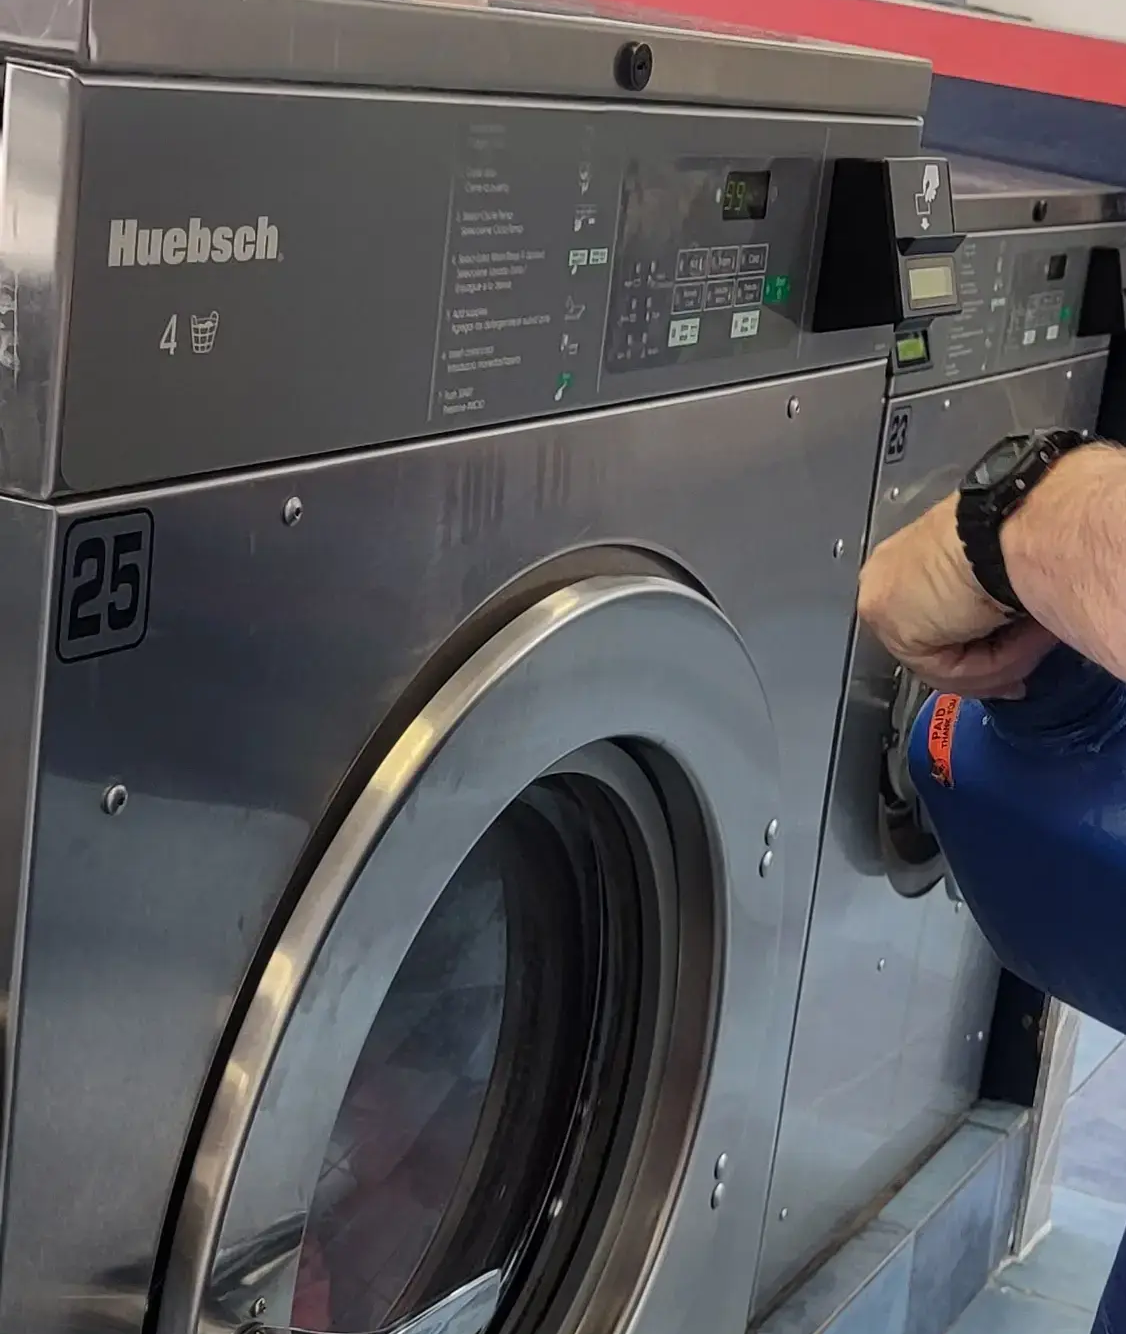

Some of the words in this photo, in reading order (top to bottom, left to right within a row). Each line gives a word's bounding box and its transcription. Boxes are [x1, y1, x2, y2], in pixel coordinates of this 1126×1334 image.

[108, 216, 279, 267] Huebsch
[159, 314, 178, 355] 4
[68, 530, 143, 641] 25
[932, 708, 946, 741] PAID
[941, 718, 952, 749] THANK
